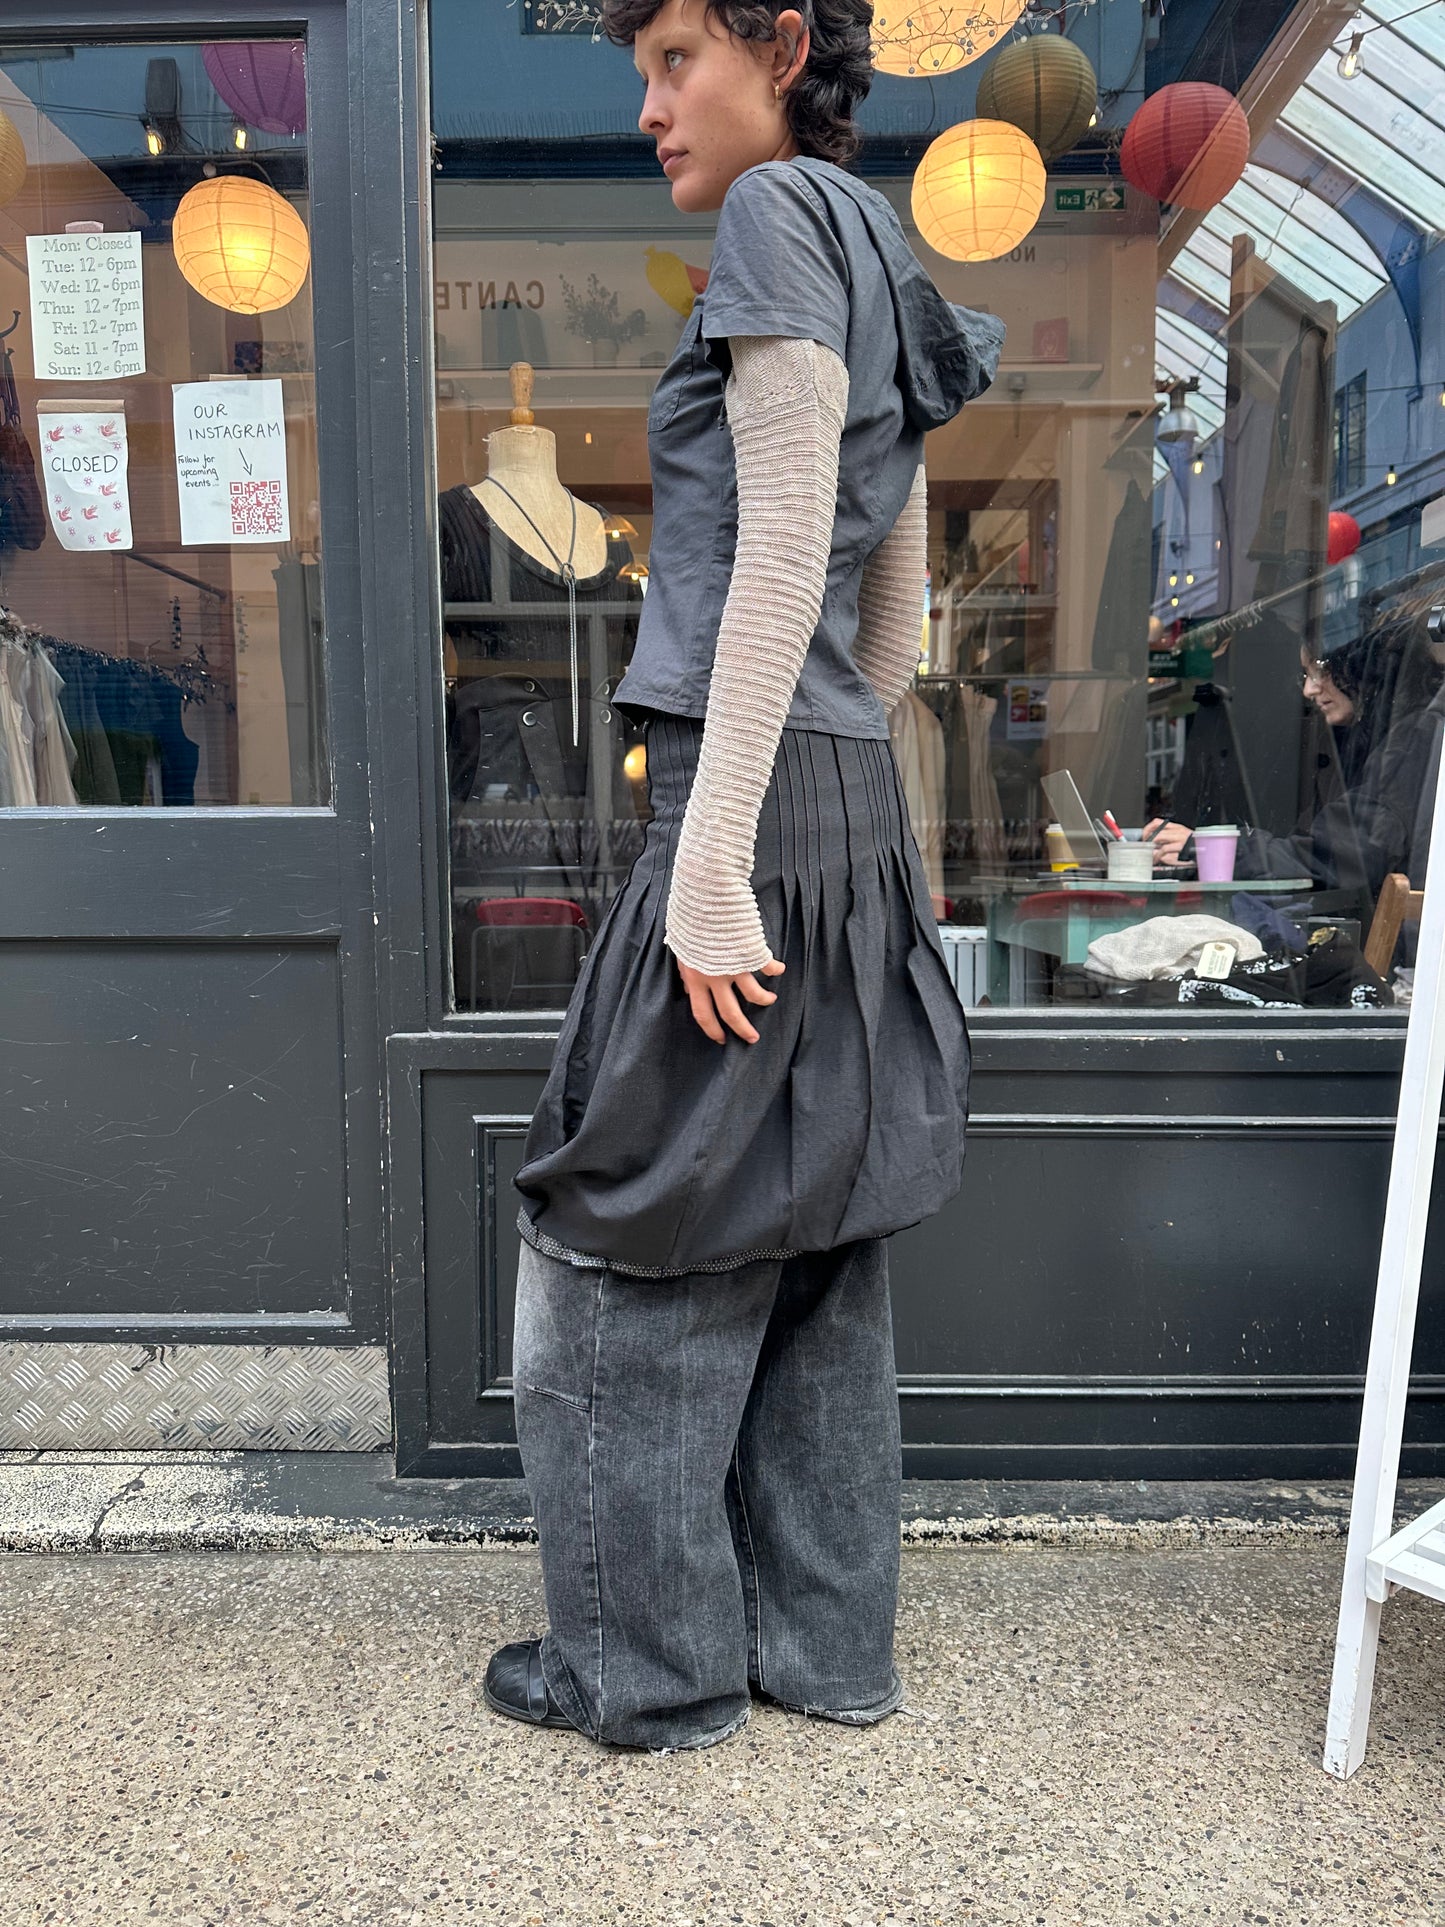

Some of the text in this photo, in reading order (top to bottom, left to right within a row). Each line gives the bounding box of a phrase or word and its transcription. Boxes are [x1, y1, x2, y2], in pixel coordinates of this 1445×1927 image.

[43, 235, 133, 252] Mon: Closed
[42, 259, 75, 273] Tue:
[41, 279, 80, 293] Wed:
[39, 300, 75, 314] Thu:
[52, 321, 78, 335] Fri:
[53, 341, 80, 355] Sat:
[48, 361, 81, 375] Sun:
[194, 403, 228, 418] OUR
[189, 422, 281, 440] INSTAGRAM
[51, 455, 118, 473] CLOSED
[178, 453, 215, 469] Follow for
[180, 468, 219, 480] upcoming
